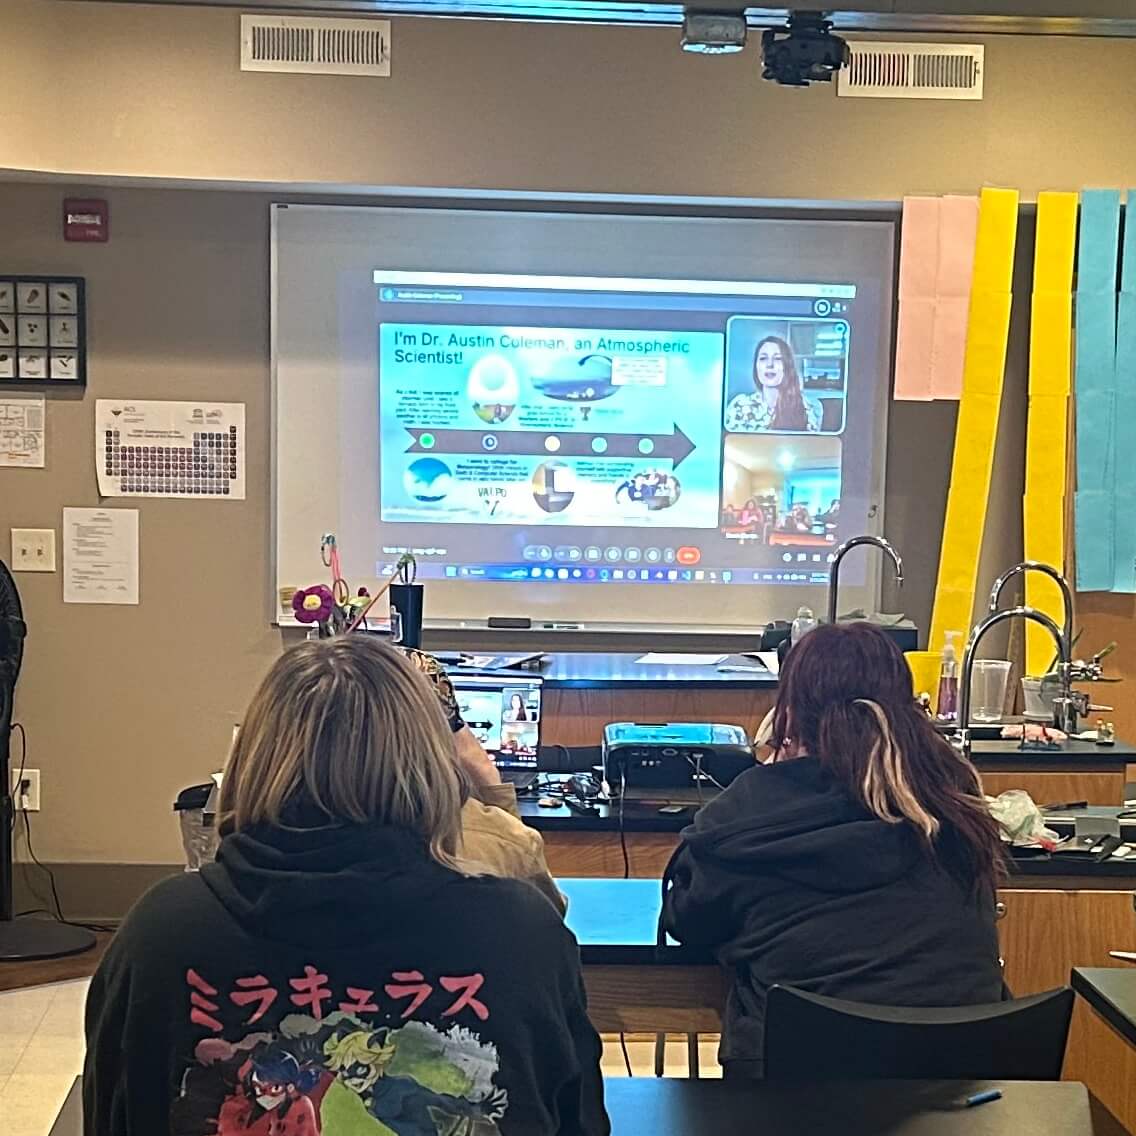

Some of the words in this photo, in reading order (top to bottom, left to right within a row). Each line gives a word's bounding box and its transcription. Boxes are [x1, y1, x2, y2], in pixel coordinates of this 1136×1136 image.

[394, 331, 417, 346] I'm
[421, 332, 443, 347] Dr.
[447, 333, 495, 348] Austin
[574, 339, 592, 350] an
[597, 338, 690, 354] Atmospheric
[394, 349, 463, 365] Scientist!
[186, 965, 490, 1032] ミラキュラス
